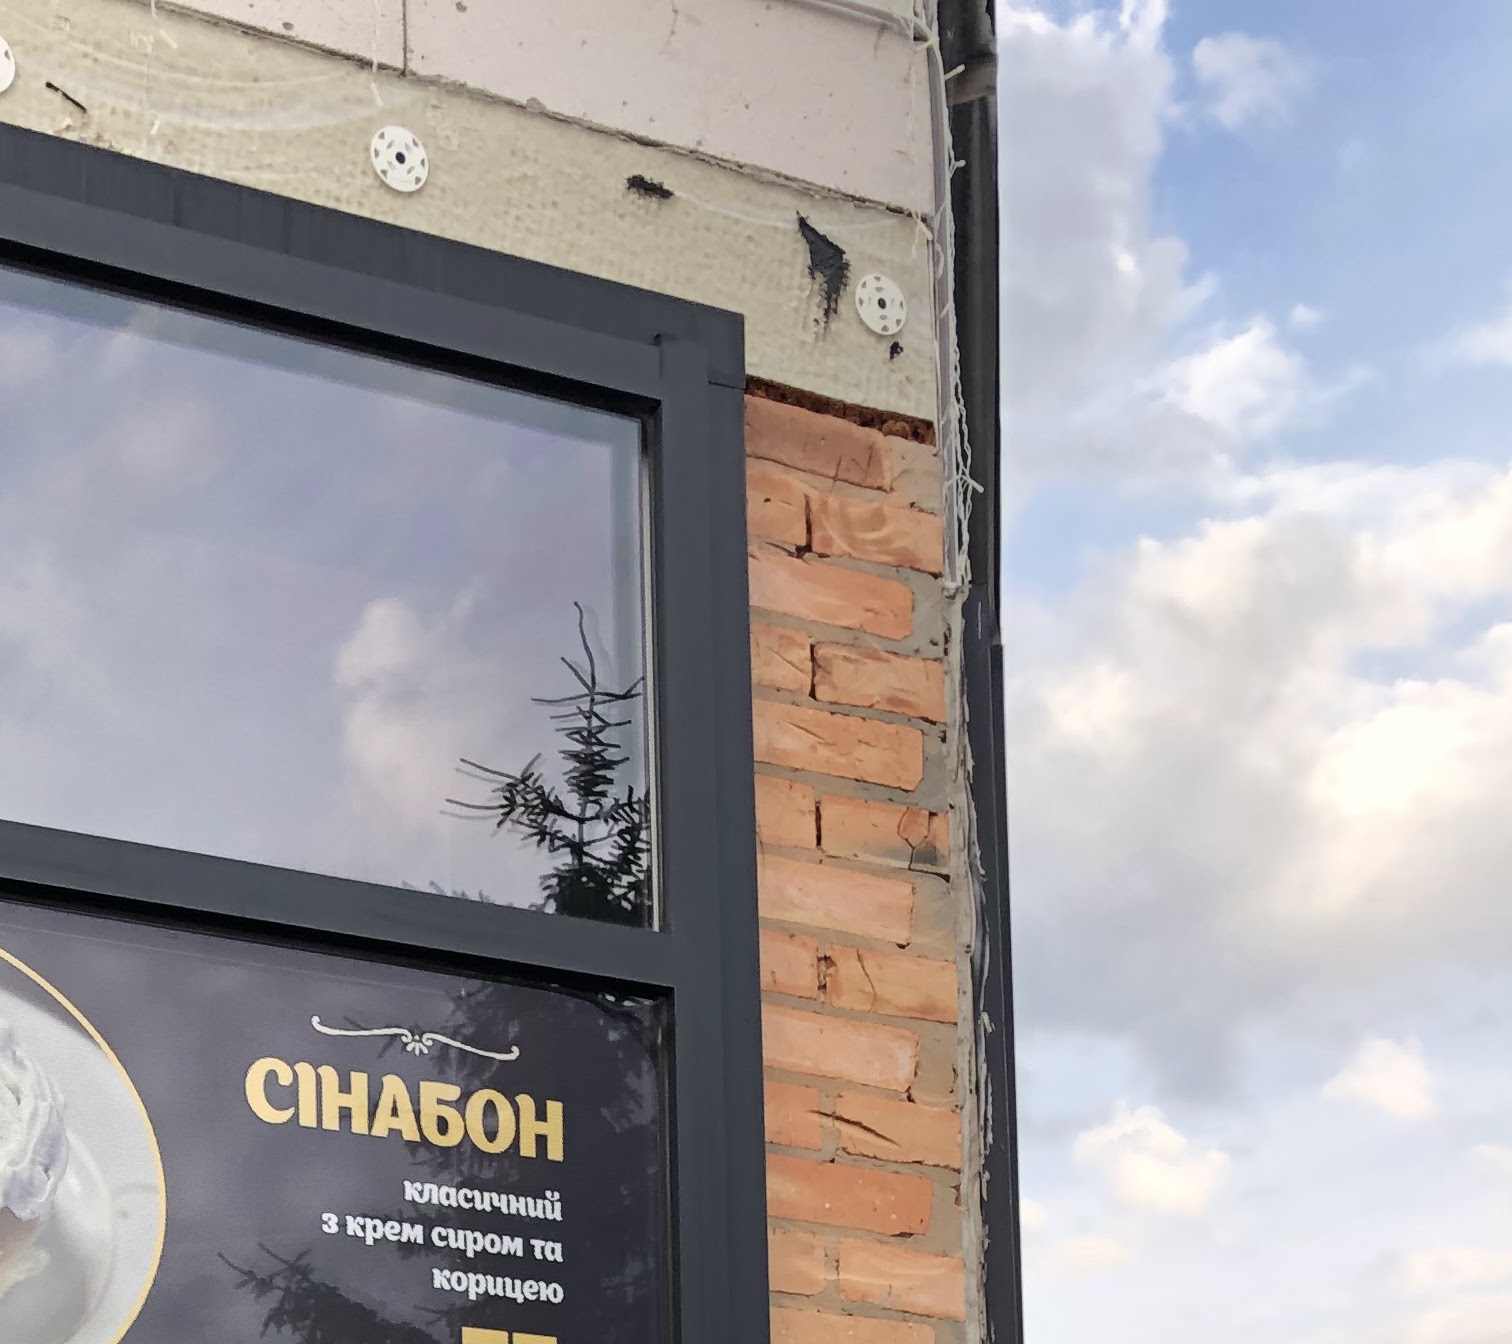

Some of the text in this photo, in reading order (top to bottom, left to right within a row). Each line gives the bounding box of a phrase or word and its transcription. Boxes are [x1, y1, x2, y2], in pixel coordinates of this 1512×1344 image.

[245, 1057, 564, 1162] СІНАБОН
[404, 1180, 563, 1221] класичний
[321, 1212, 563, 1263] з крем сиром та
[432, 1267, 564, 1303] корицею
